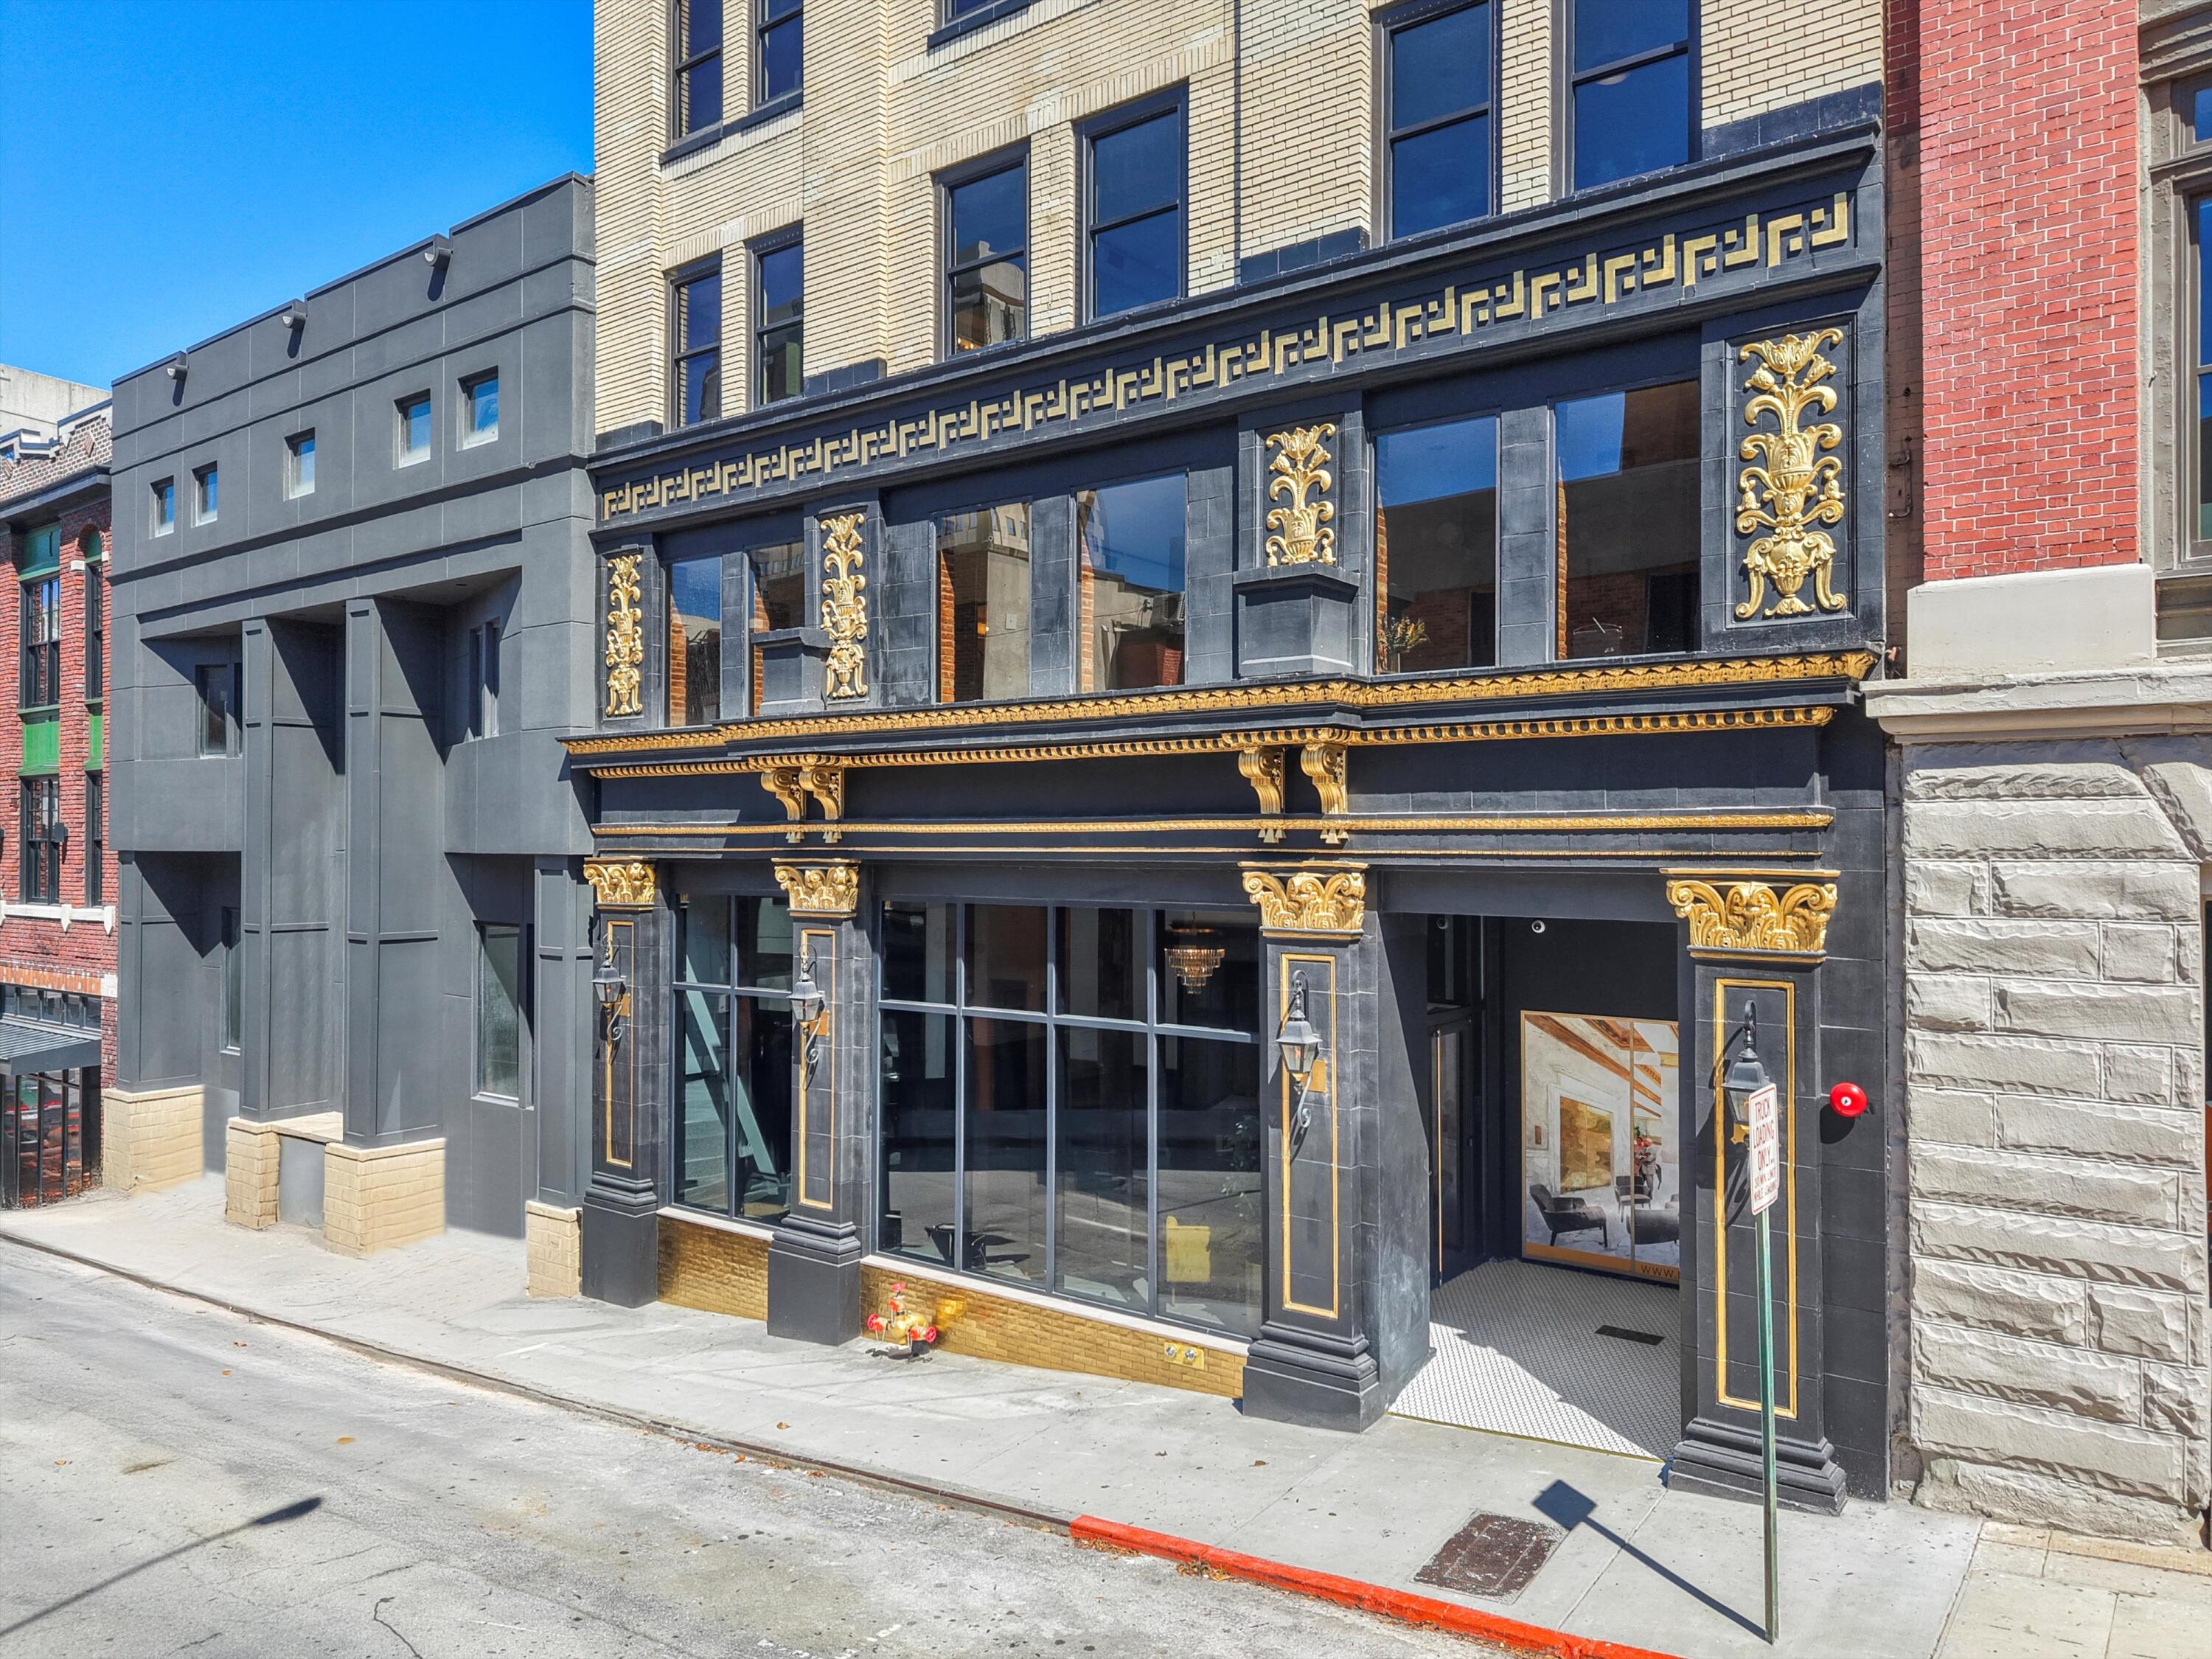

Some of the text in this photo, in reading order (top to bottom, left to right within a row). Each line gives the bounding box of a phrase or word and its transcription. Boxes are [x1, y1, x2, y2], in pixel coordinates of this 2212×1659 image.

[1755, 1098, 1771, 1121] TRUCK
[1753, 1119, 1774, 1148] LOADING
[1758, 1147, 1770, 1170] ONLY
